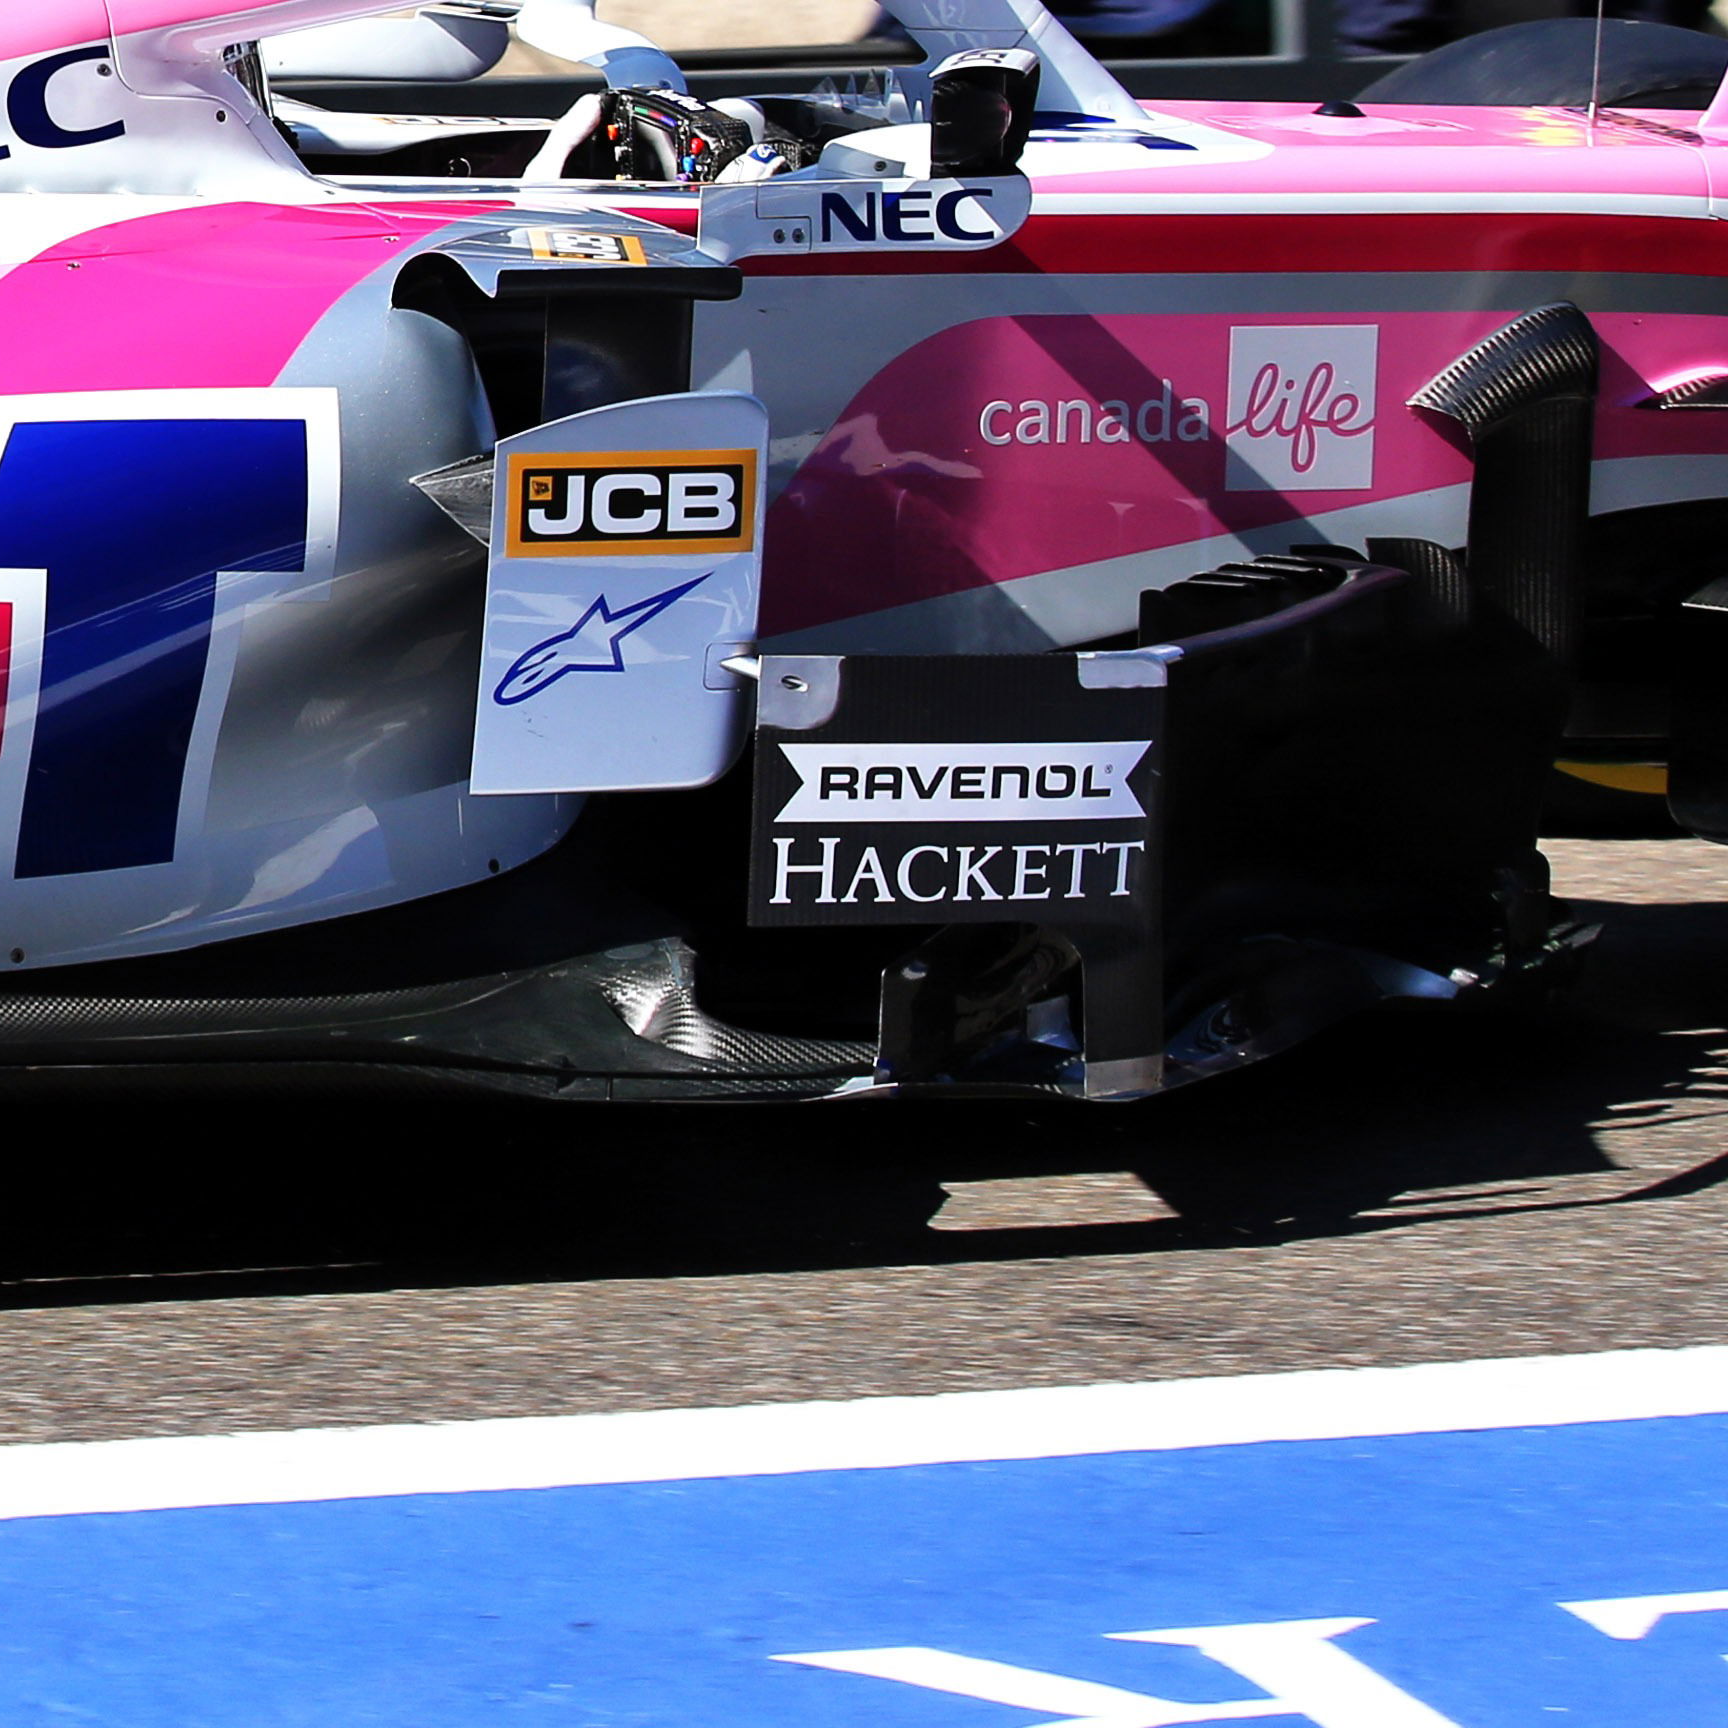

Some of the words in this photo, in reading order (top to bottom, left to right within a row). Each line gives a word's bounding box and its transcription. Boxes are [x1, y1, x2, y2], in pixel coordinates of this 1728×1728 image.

[821, 188, 995, 243] NEC
[979, 378, 1210, 447] canada
[1226, 362, 1375, 473] life
[528, 472, 736, 535] JCB
[819, 763, 1112, 801] RAVENOL
[769, 838, 1145, 905] HACKETT
